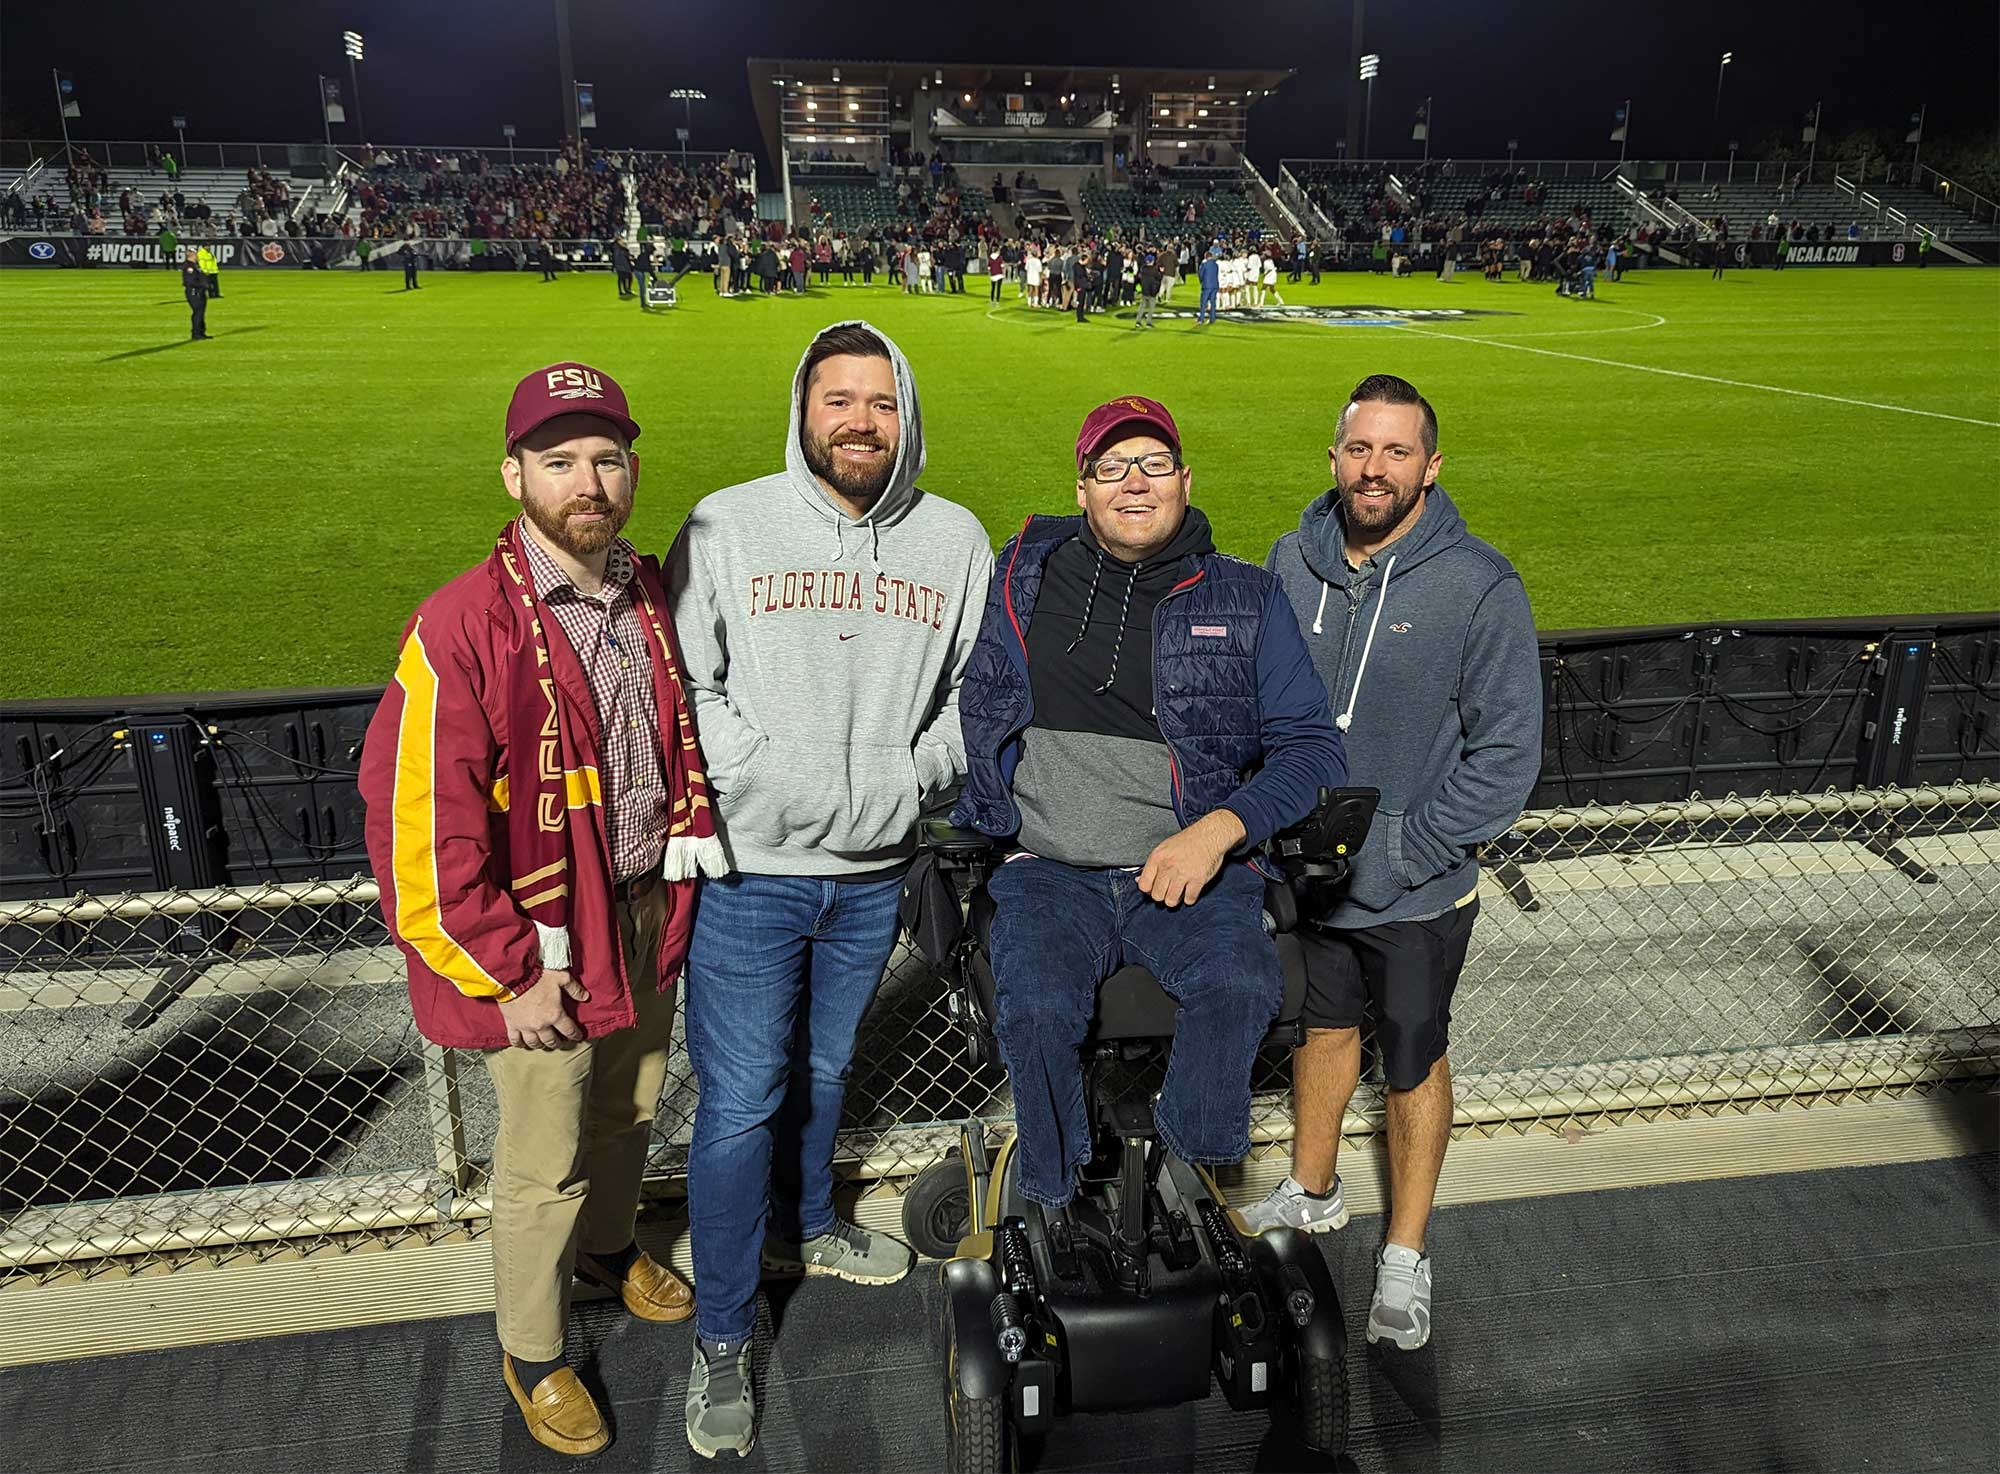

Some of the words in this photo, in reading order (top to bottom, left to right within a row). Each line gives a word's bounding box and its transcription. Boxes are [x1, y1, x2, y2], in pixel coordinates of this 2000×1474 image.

[1786, 246, 1859, 263] NCAA.COM
[547, 368, 603, 391] FSU
[749, 570, 863, 618] FLORIDA
[873, 573, 946, 632] STATE
